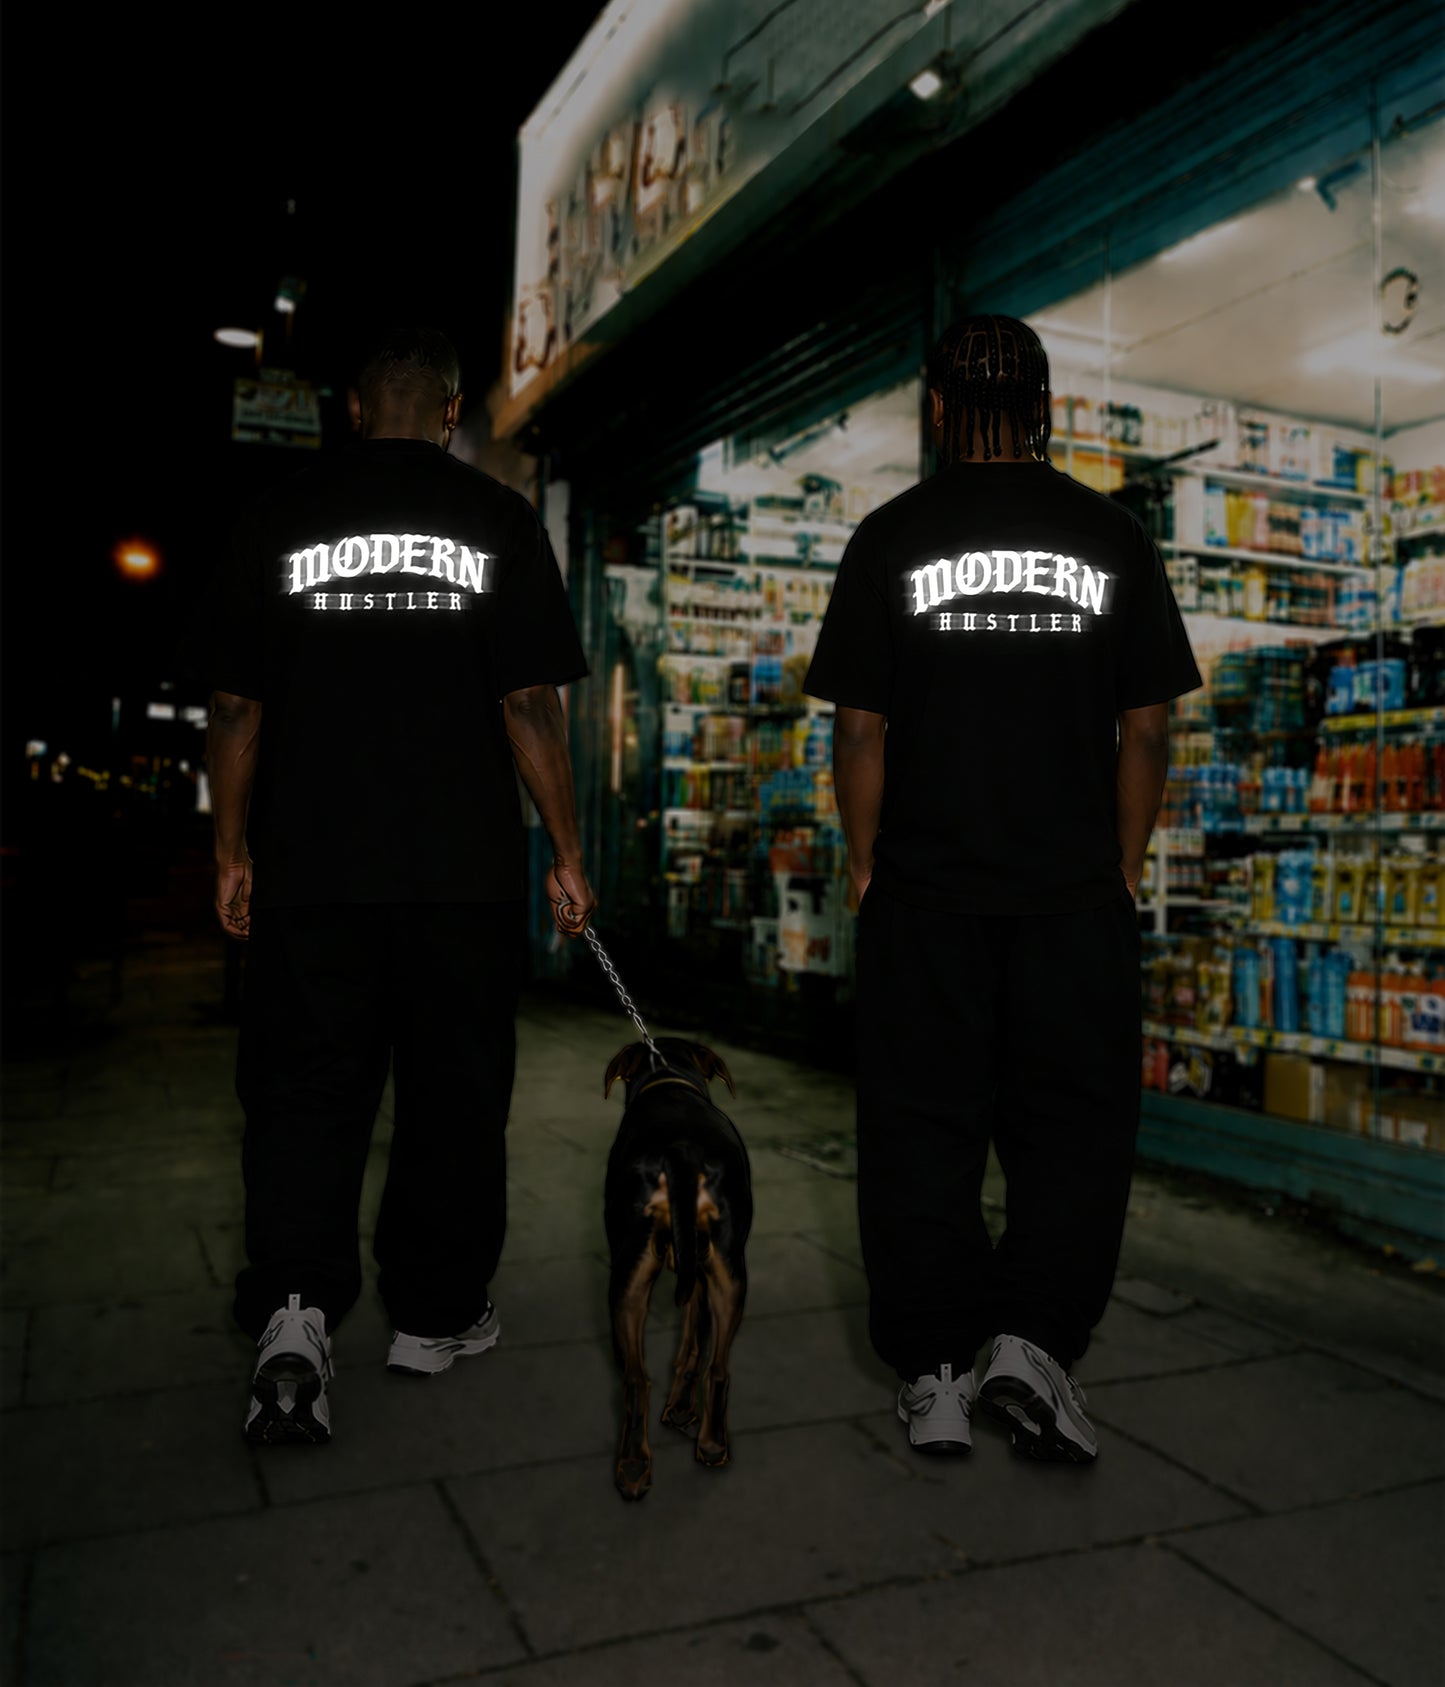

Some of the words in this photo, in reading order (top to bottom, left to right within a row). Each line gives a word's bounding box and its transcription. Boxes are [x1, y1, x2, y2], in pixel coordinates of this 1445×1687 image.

[288, 533, 489, 596] MODERN
[910, 550, 1109, 616] MODERN
[313, 591, 462, 611] HUSTLER
[938, 612, 1082, 633] HUSTLER
